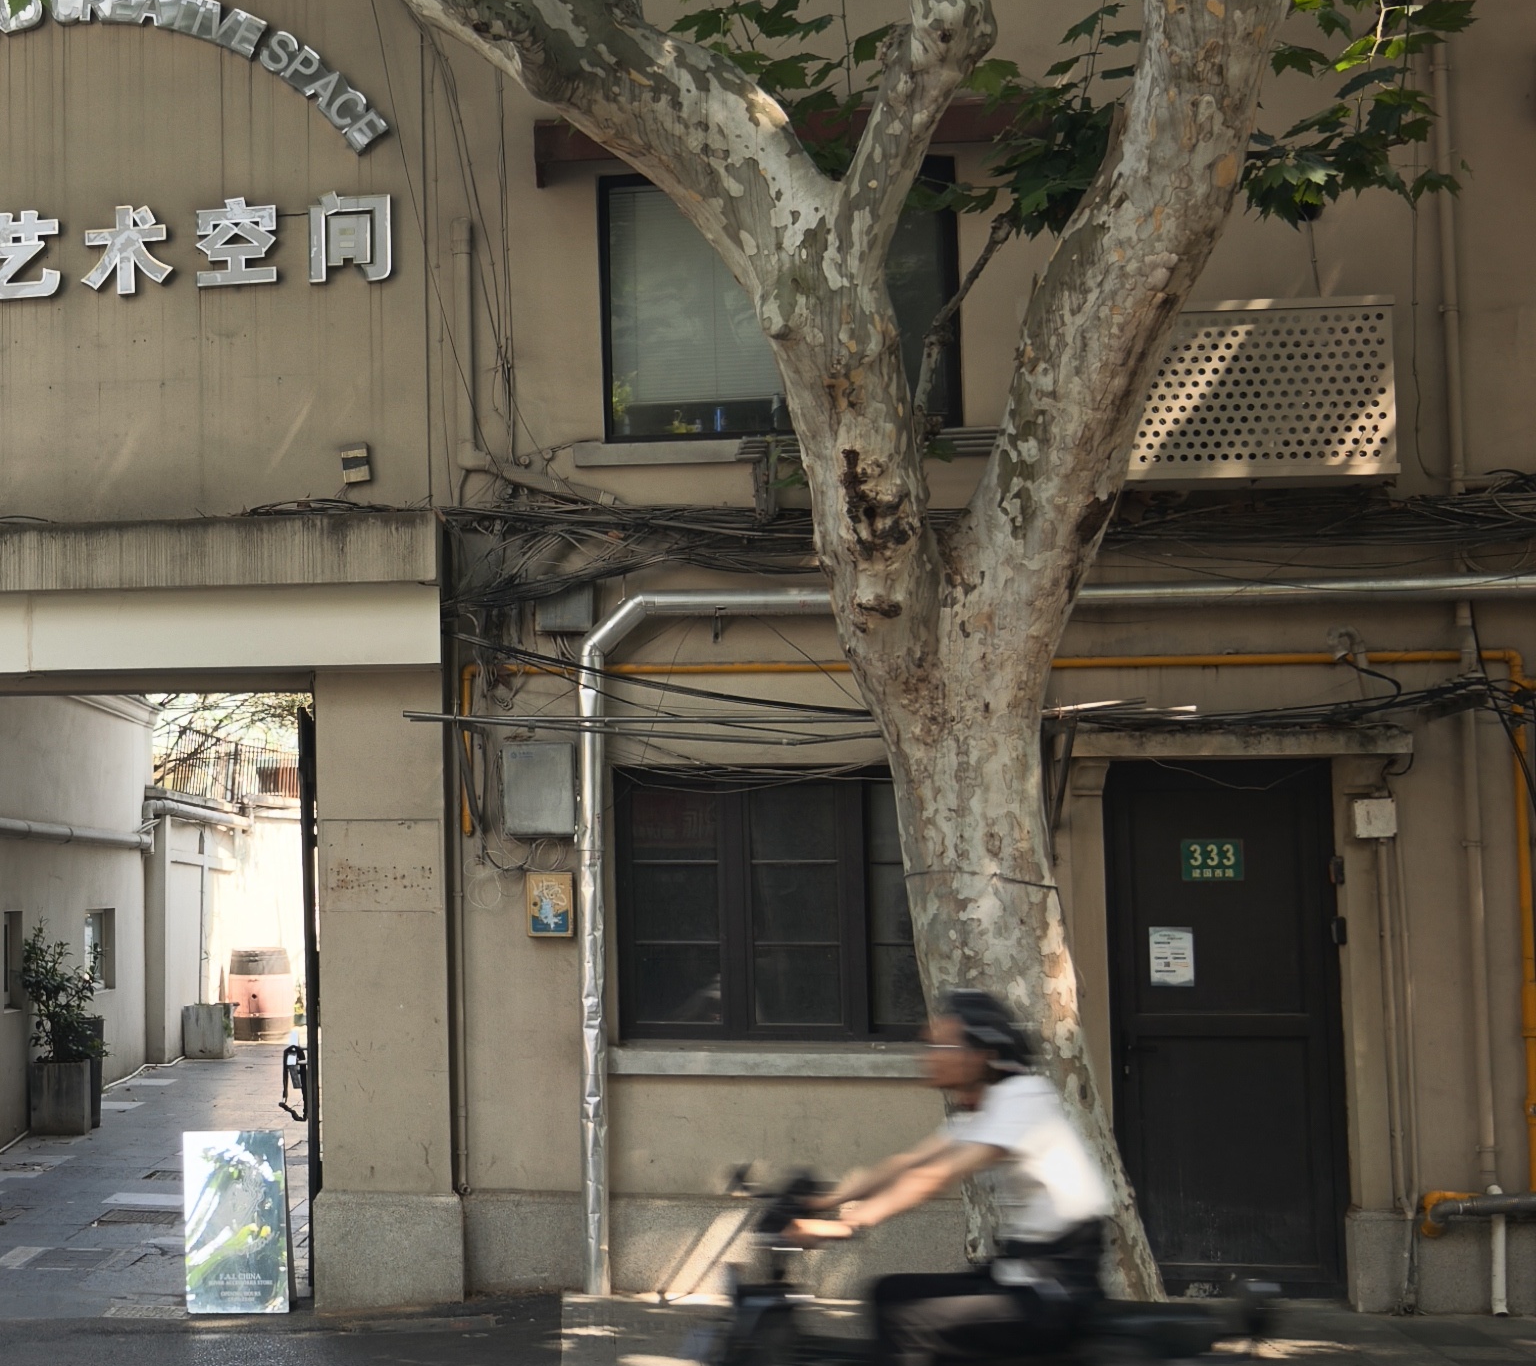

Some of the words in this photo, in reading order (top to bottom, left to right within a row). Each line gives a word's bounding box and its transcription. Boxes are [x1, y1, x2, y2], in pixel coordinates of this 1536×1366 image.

[259, 30, 390, 155] SPACE
[1189, 844, 1235, 866] 333
[1192, 868, 1234, 878] 建国西路
